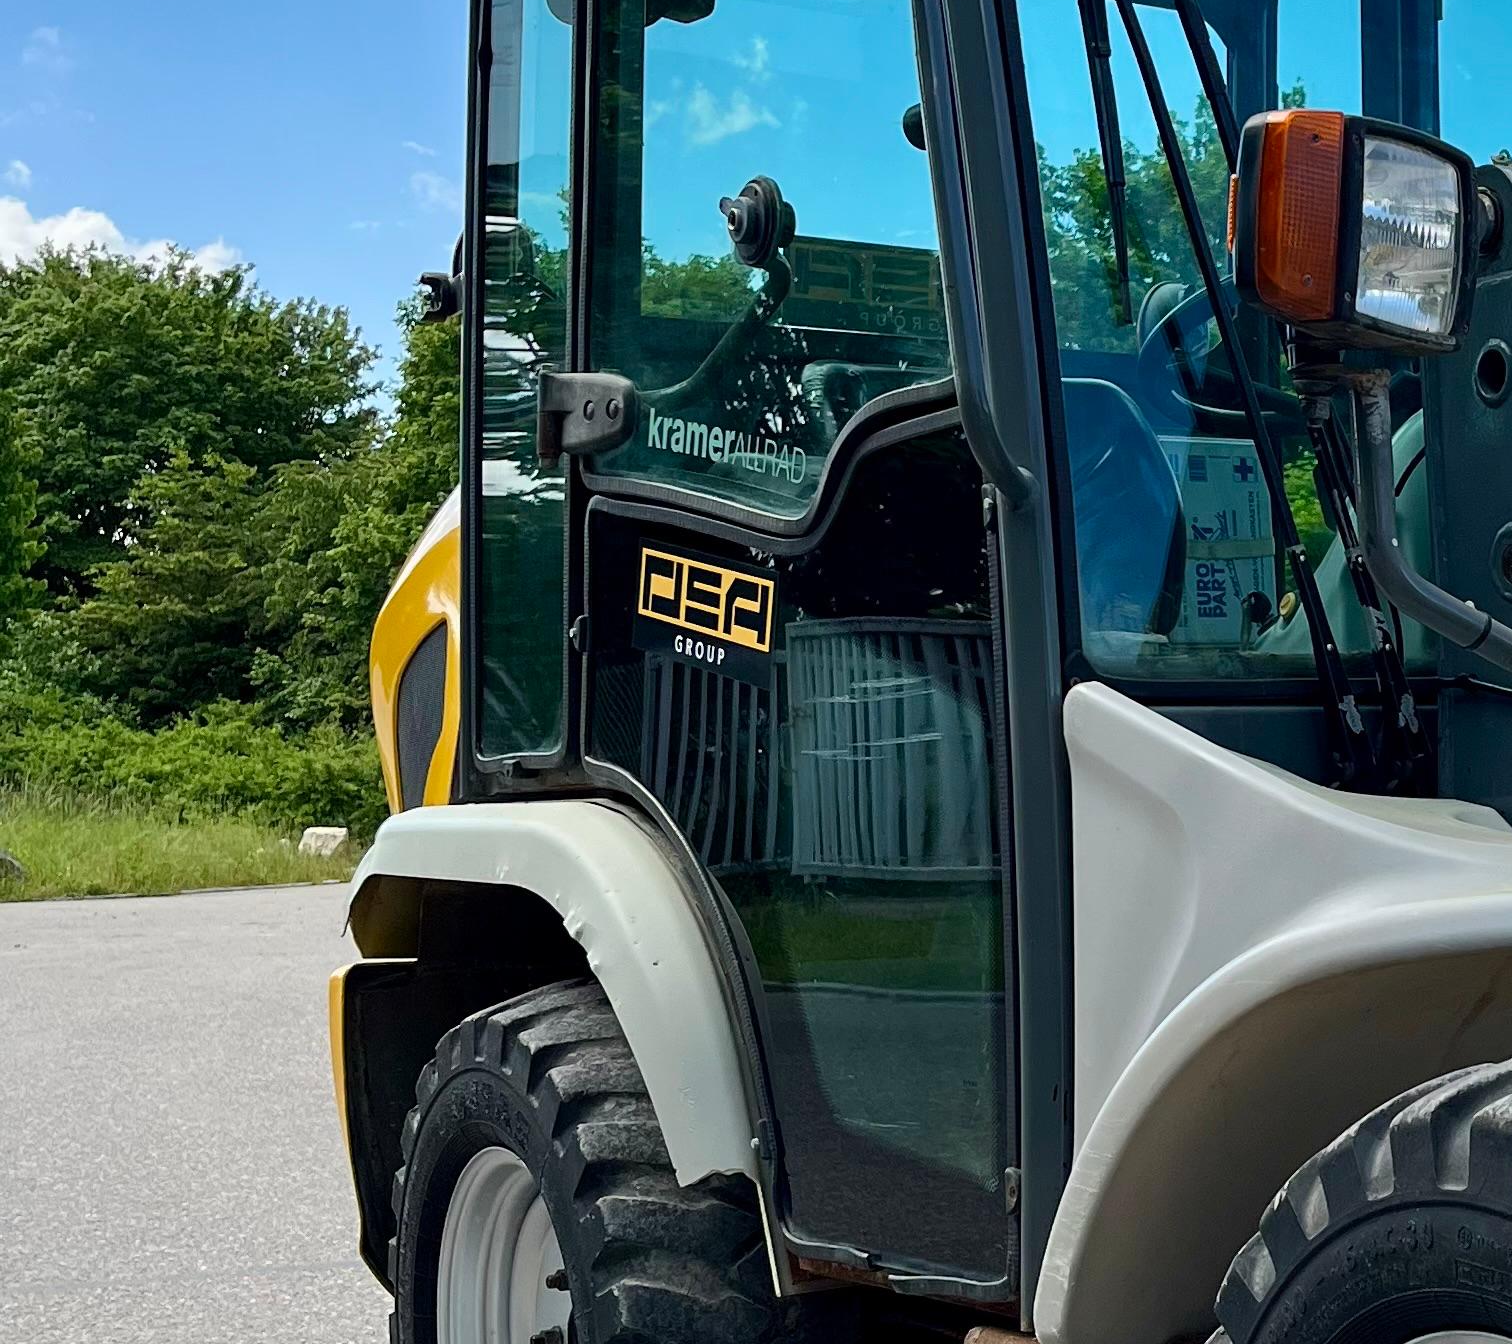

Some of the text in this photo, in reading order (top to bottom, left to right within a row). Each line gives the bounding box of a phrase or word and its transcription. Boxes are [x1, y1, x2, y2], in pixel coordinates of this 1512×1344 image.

[647, 407, 806, 484] kramerALLRAD
[1196, 563, 1211, 617] EURO
[1210, 562, 1227, 618] PART
[674, 634, 725, 666] GROUP
